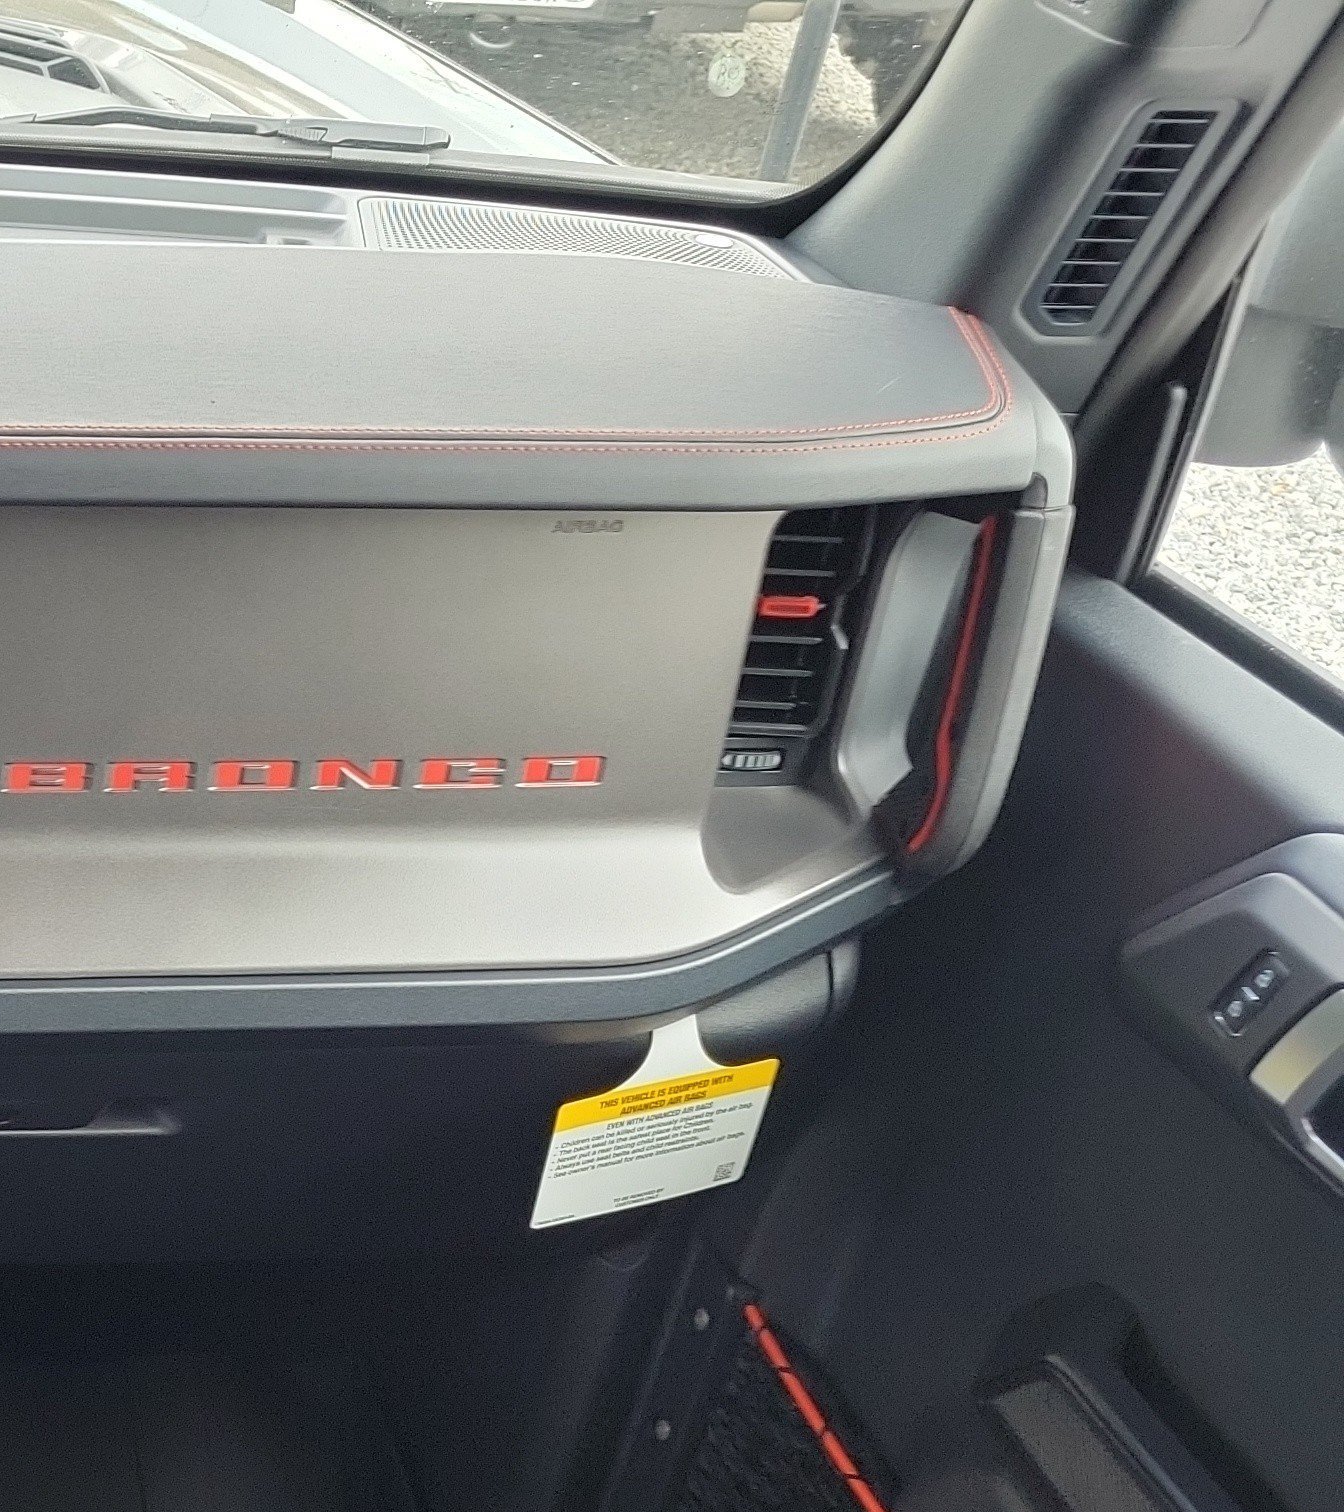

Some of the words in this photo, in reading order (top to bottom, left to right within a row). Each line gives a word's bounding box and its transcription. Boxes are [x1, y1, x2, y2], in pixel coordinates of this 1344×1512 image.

[551, 520, 623, 533] AIRBAG
[0, 755, 608, 793] BRONCO
[599, 1098, 618, 1109] THIS
[621, 1091, 656, 1105] VEHICLE
[657, 1088, 666, 1098] IS
[667, 1079, 710, 1094] EQUIPPED
[711, 1075, 734, 1086] WITH
[620, 1100, 665, 1116] ADVANCED
[667, 1095, 683, 1105] AIR
[684, 1090, 708, 1101] BAGS
[606, 1120, 625, 1130] EVEN
[626, 1116, 644, 1126] WITH
[645, 1109, 681, 1121] ADVANCED
[682, 1105, 694, 1114] AIR
